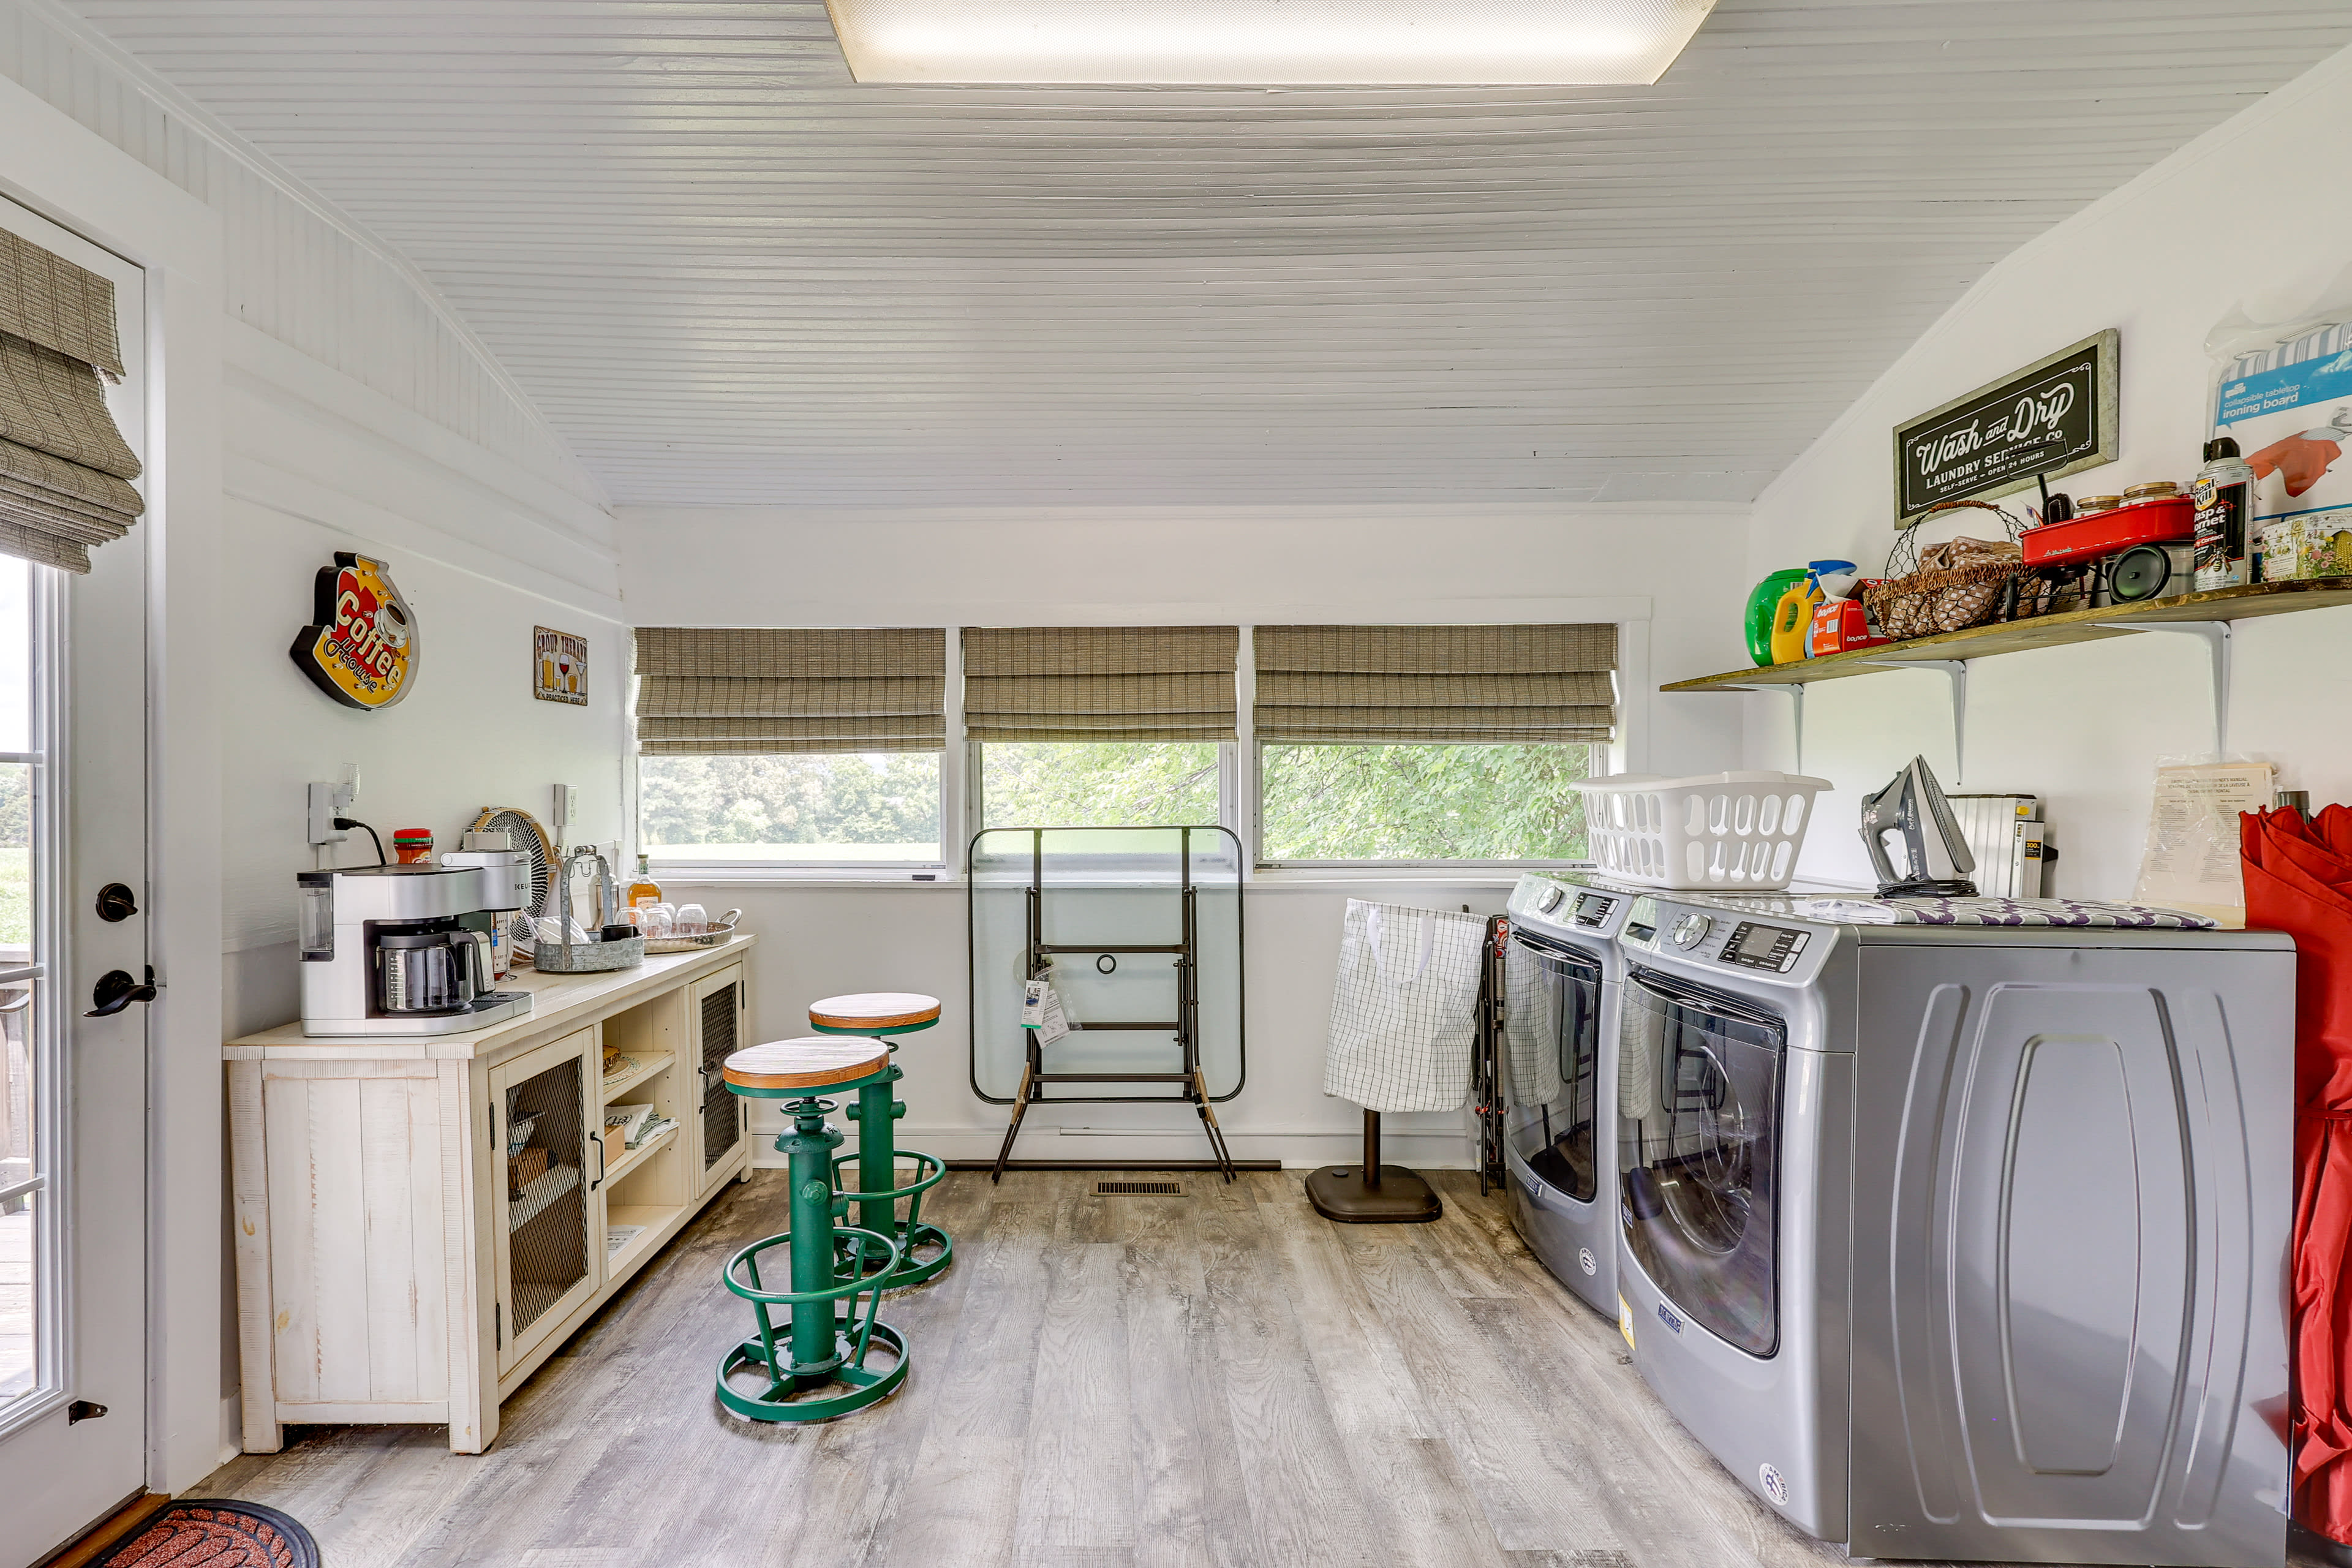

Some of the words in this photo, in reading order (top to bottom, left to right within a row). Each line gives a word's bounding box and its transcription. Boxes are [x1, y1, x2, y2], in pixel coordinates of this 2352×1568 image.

[2223, 403, 2261, 419] ironing
[2263, 392, 2299, 409] board
[2224, 393, 2264, 407] collapsible
[2266, 384, 2300, 397] tabletop
[1916, 418, 1983, 475] Wash
[1985, 416, 2010, 440] and
[2007, 382, 2075, 442] Dry
[1926, 459, 1981, 489] LAUNDRY
[1940, 475, 1978, 493] SELF-SERVE
[1988, 465, 2006, 476] OPEN
[2008, 461, 2018, 469] 24
[2020, 451, 2045, 464] HOURS
[337, 590, 402, 688] Coffee
[537, 634, 557, 659] GROUP
[561, 636, 587, 664] THERAPY
[324, 638, 377, 694] House
[546, 693, 568, 703] PRACTICED
[1770, 1466, 1787, 1502] AMERICA
